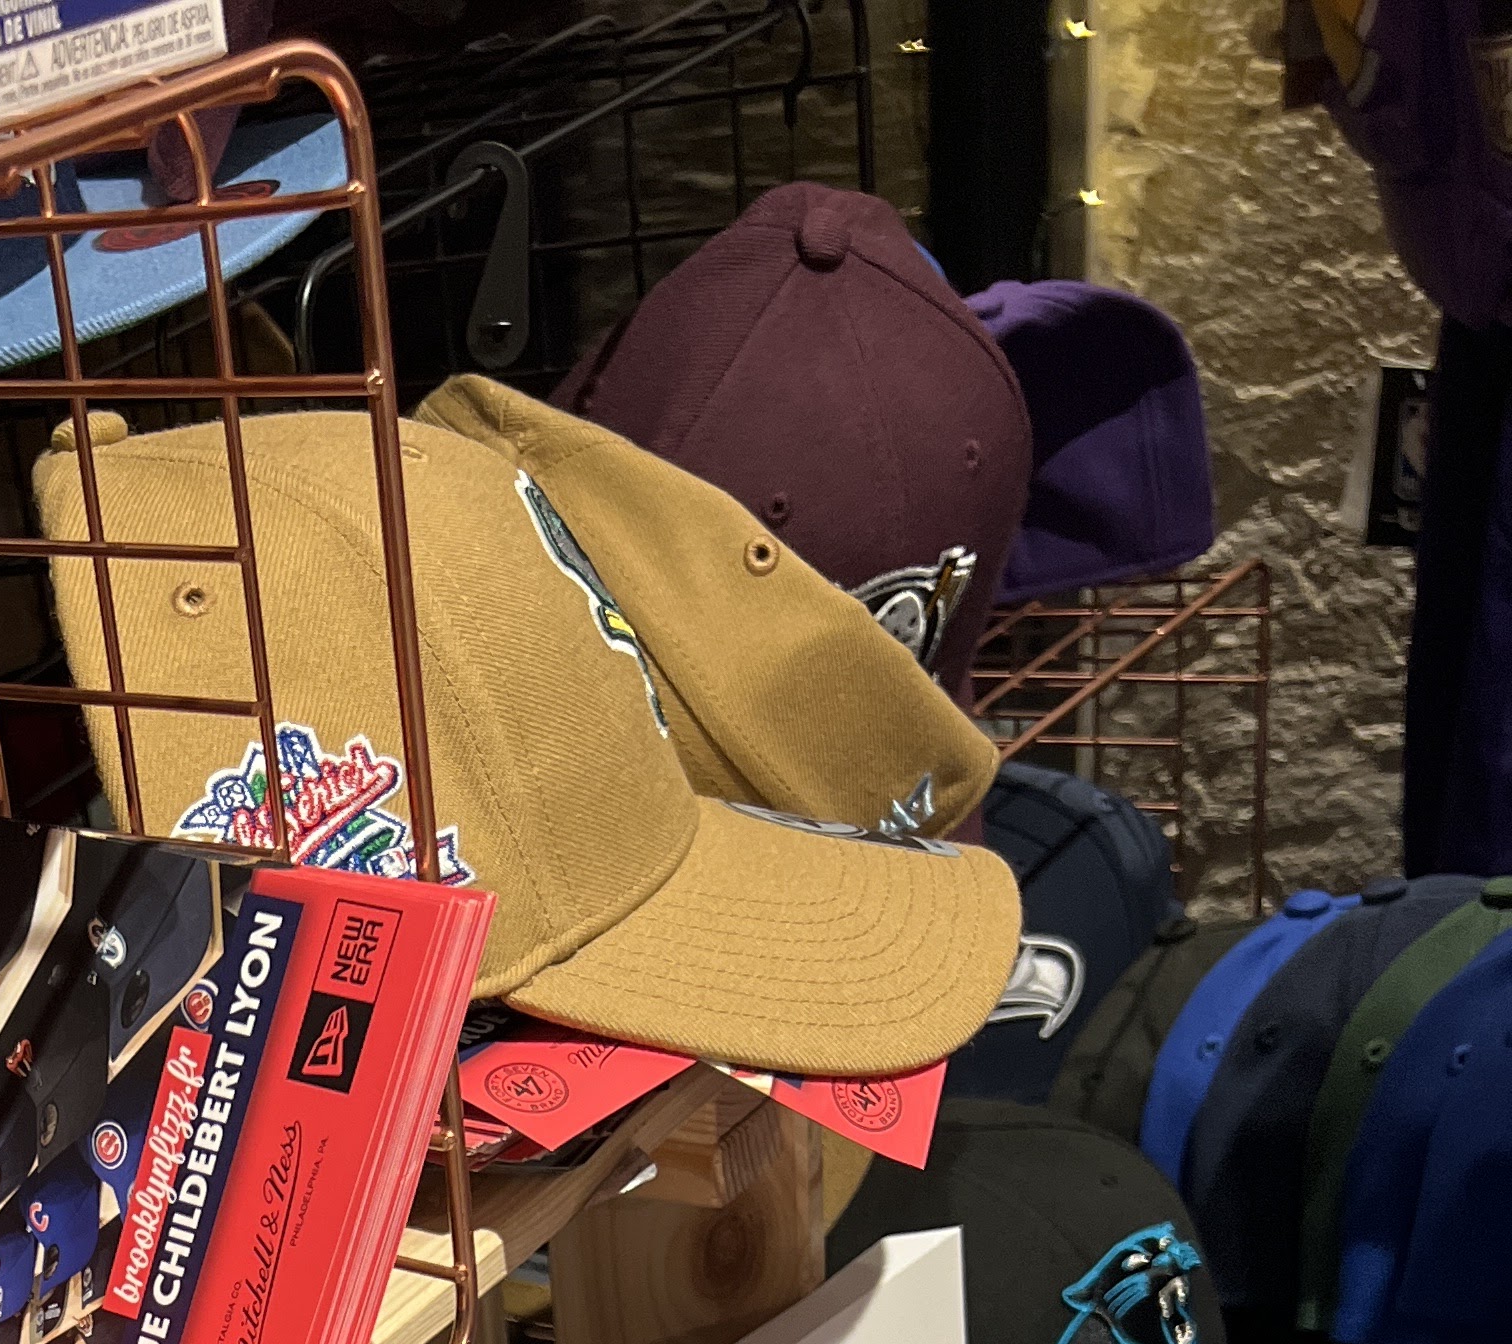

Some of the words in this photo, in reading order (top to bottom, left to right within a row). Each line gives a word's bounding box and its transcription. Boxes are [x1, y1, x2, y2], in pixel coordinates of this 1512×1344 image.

[4, 14, 24, 45] DE
[24, 5, 62, 38] VINIL
[330, 916, 365, 983] NEW
[352, 917, 384, 987] ERA
[153, 1042, 246, 1308] CHILDEBERT
[226, 910, 284, 1038] LYON
[113, 1044, 204, 1305] brooklynfizz.fr
[262, 1119, 303, 1204] Ness
[260, 1208, 280, 1236] &
